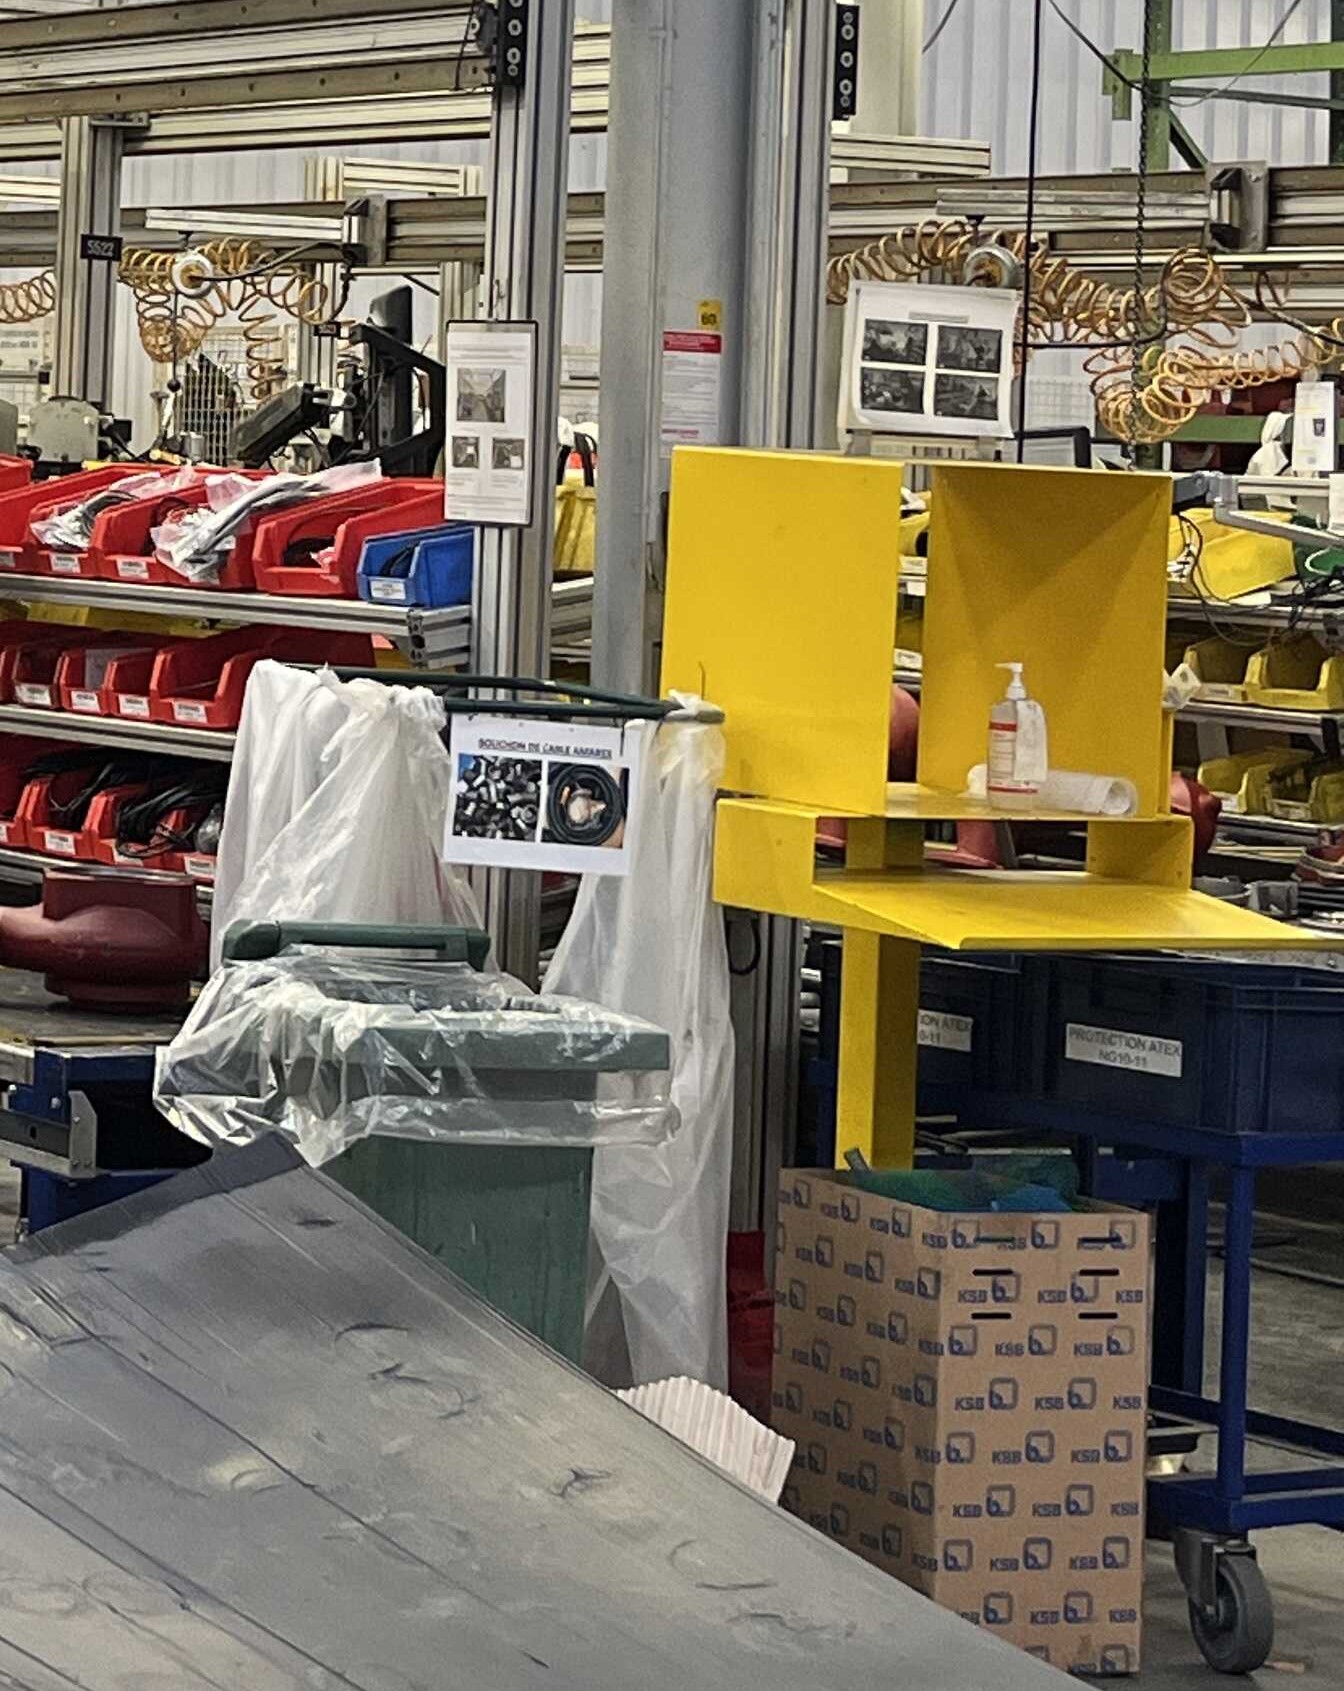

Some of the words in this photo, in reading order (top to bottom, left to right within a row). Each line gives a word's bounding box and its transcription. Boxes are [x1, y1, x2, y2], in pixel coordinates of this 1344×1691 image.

[478, 738, 526, 751] BOUCHON
[528, 743, 541, 752] DE
[543, 743, 571, 755] CABLE
[1069, 1027, 1147, 1051] PROTECTION
[1149, 1040, 1181, 1057] ATEX
[958, 1290, 987, 1303] KSB
[1038, 1290, 1067, 1303] KSB
[1116, 1290, 1143, 1303] KSB
[995, 1343, 1024, 1356] KSB
[1074, 1343, 1103, 1356] KSB
[954, 1397, 985, 1410] KSB
[1035, 1397, 1064, 1410] KSB
[1113, 1396, 1141, 1409] KSB
[992, 1450, 1022, 1464] KSB
[1071, 1449, 1100, 1464] KSB
[952, 1504, 982, 1517] KSB
[1032, 1503, 1062, 1517] KSB
[1111, 1502, 1139, 1516] KSB
[990, 1558, 1019, 1571] KSB
[1070, 1556, 1098, 1569] KSB
[1030, 1611, 1060, 1624] KSB
[1109, 1609, 1137, 1623] KSB
